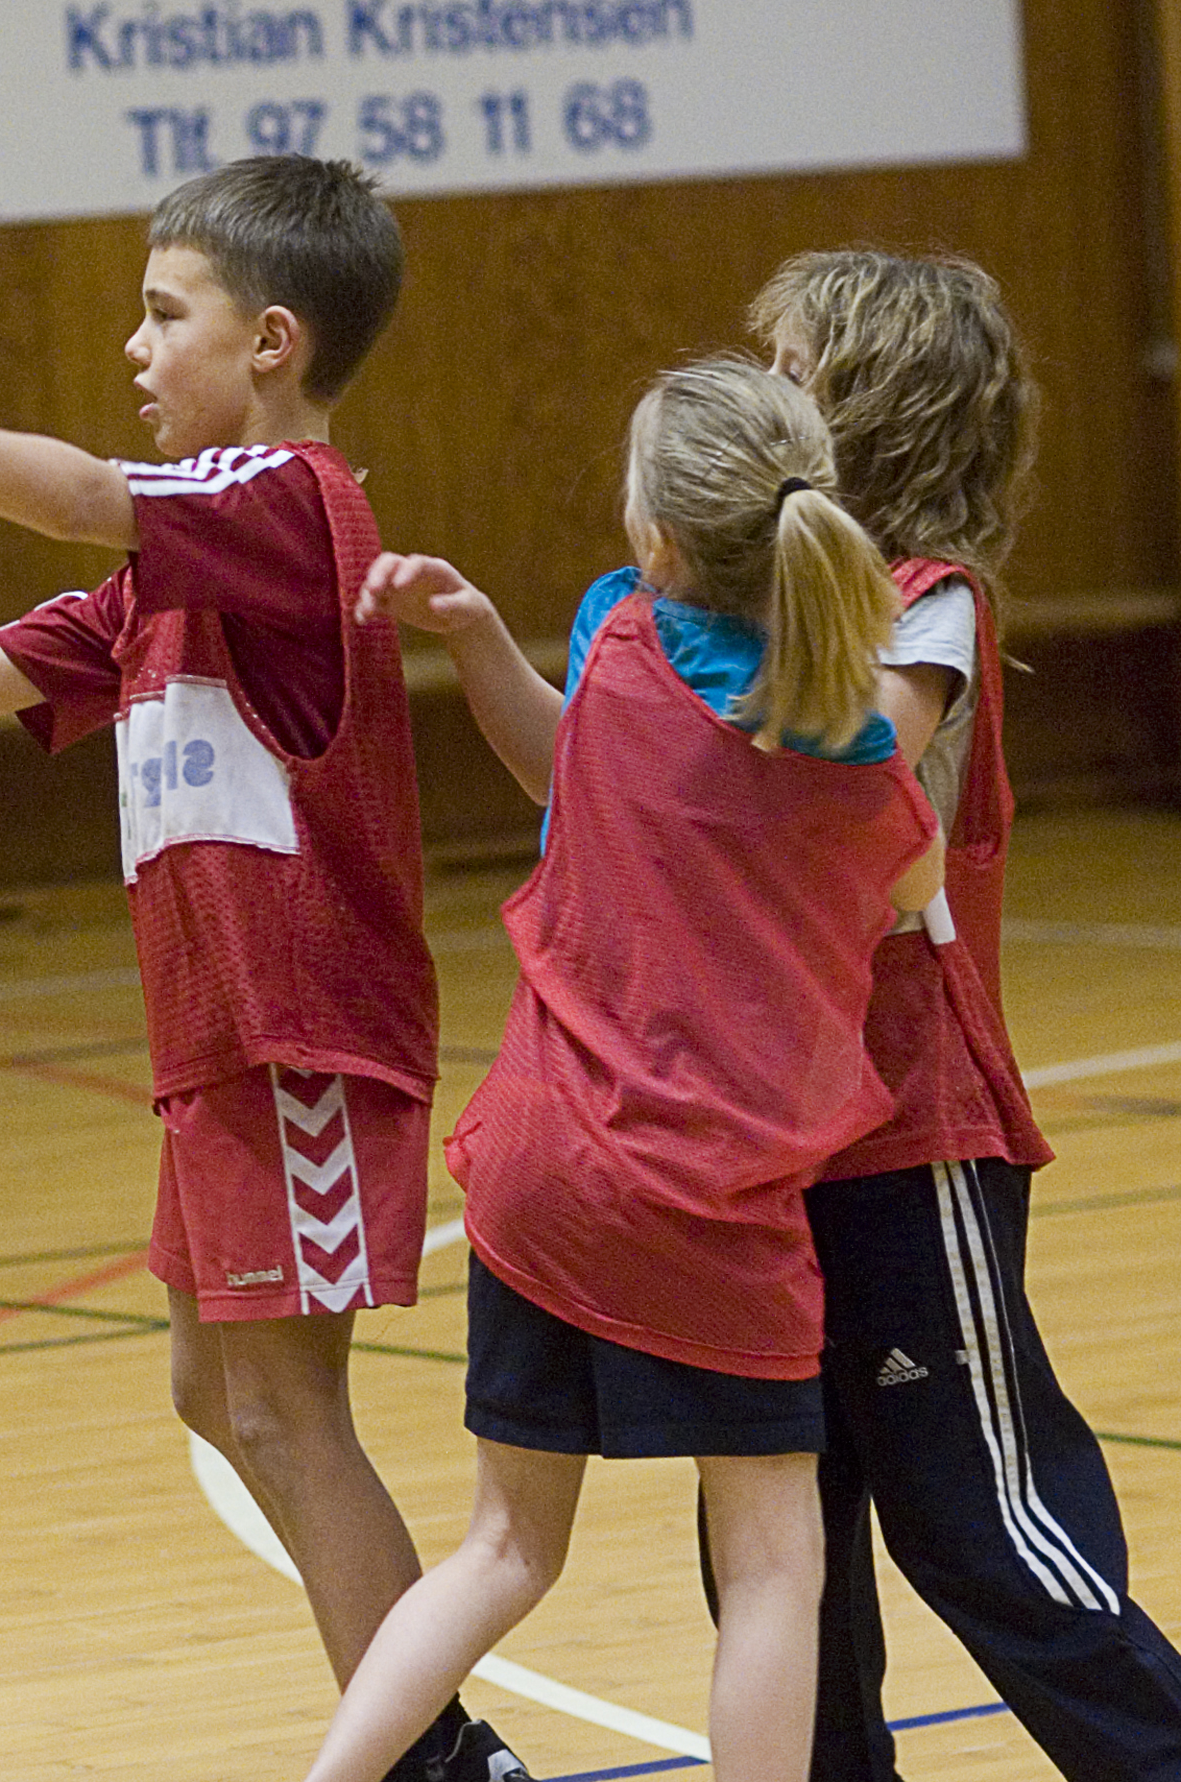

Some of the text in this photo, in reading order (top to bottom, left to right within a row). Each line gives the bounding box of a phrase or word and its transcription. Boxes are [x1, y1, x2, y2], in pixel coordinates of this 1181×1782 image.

[65, 0, 695, 72] Kristian Kristensen
[245, 99, 327, 156] 97
[359, 92, 443, 164] 58
[479, 89, 531, 155] 11
[563, 78, 653, 152] 68
